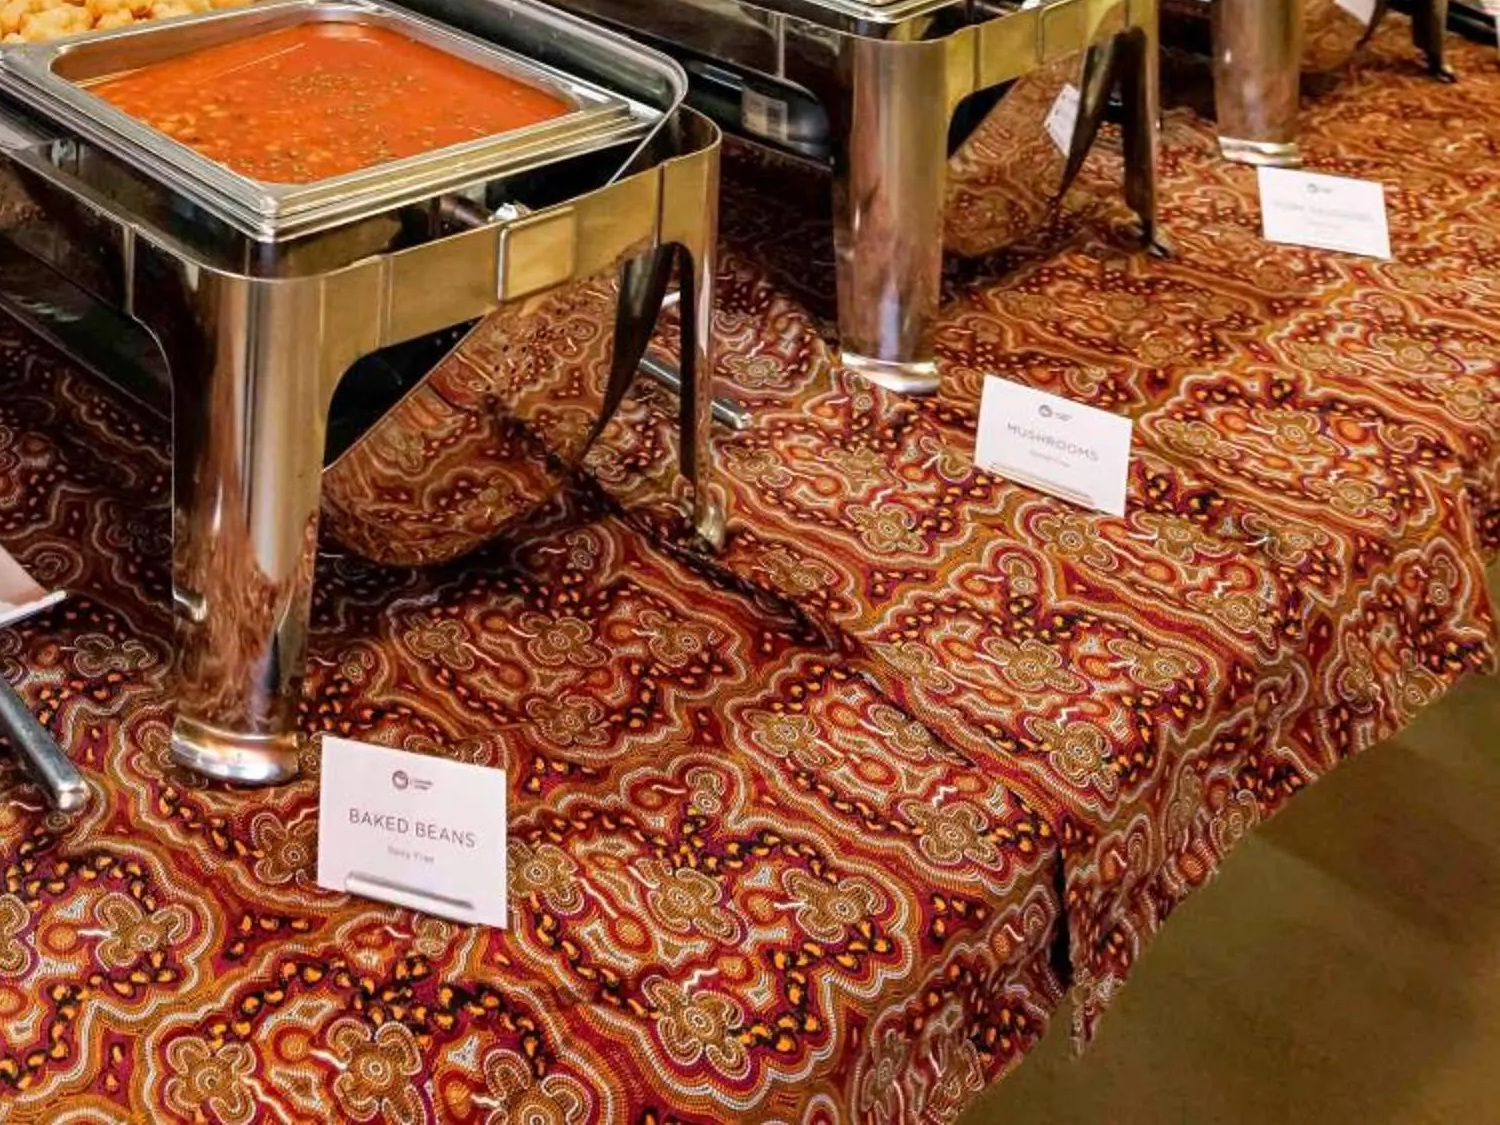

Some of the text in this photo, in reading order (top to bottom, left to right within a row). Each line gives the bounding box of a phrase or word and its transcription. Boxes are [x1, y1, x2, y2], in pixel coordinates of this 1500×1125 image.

[1007, 421, 1100, 462] MUSHROOMS
[348, 807, 476, 849] BAKED BEANS
